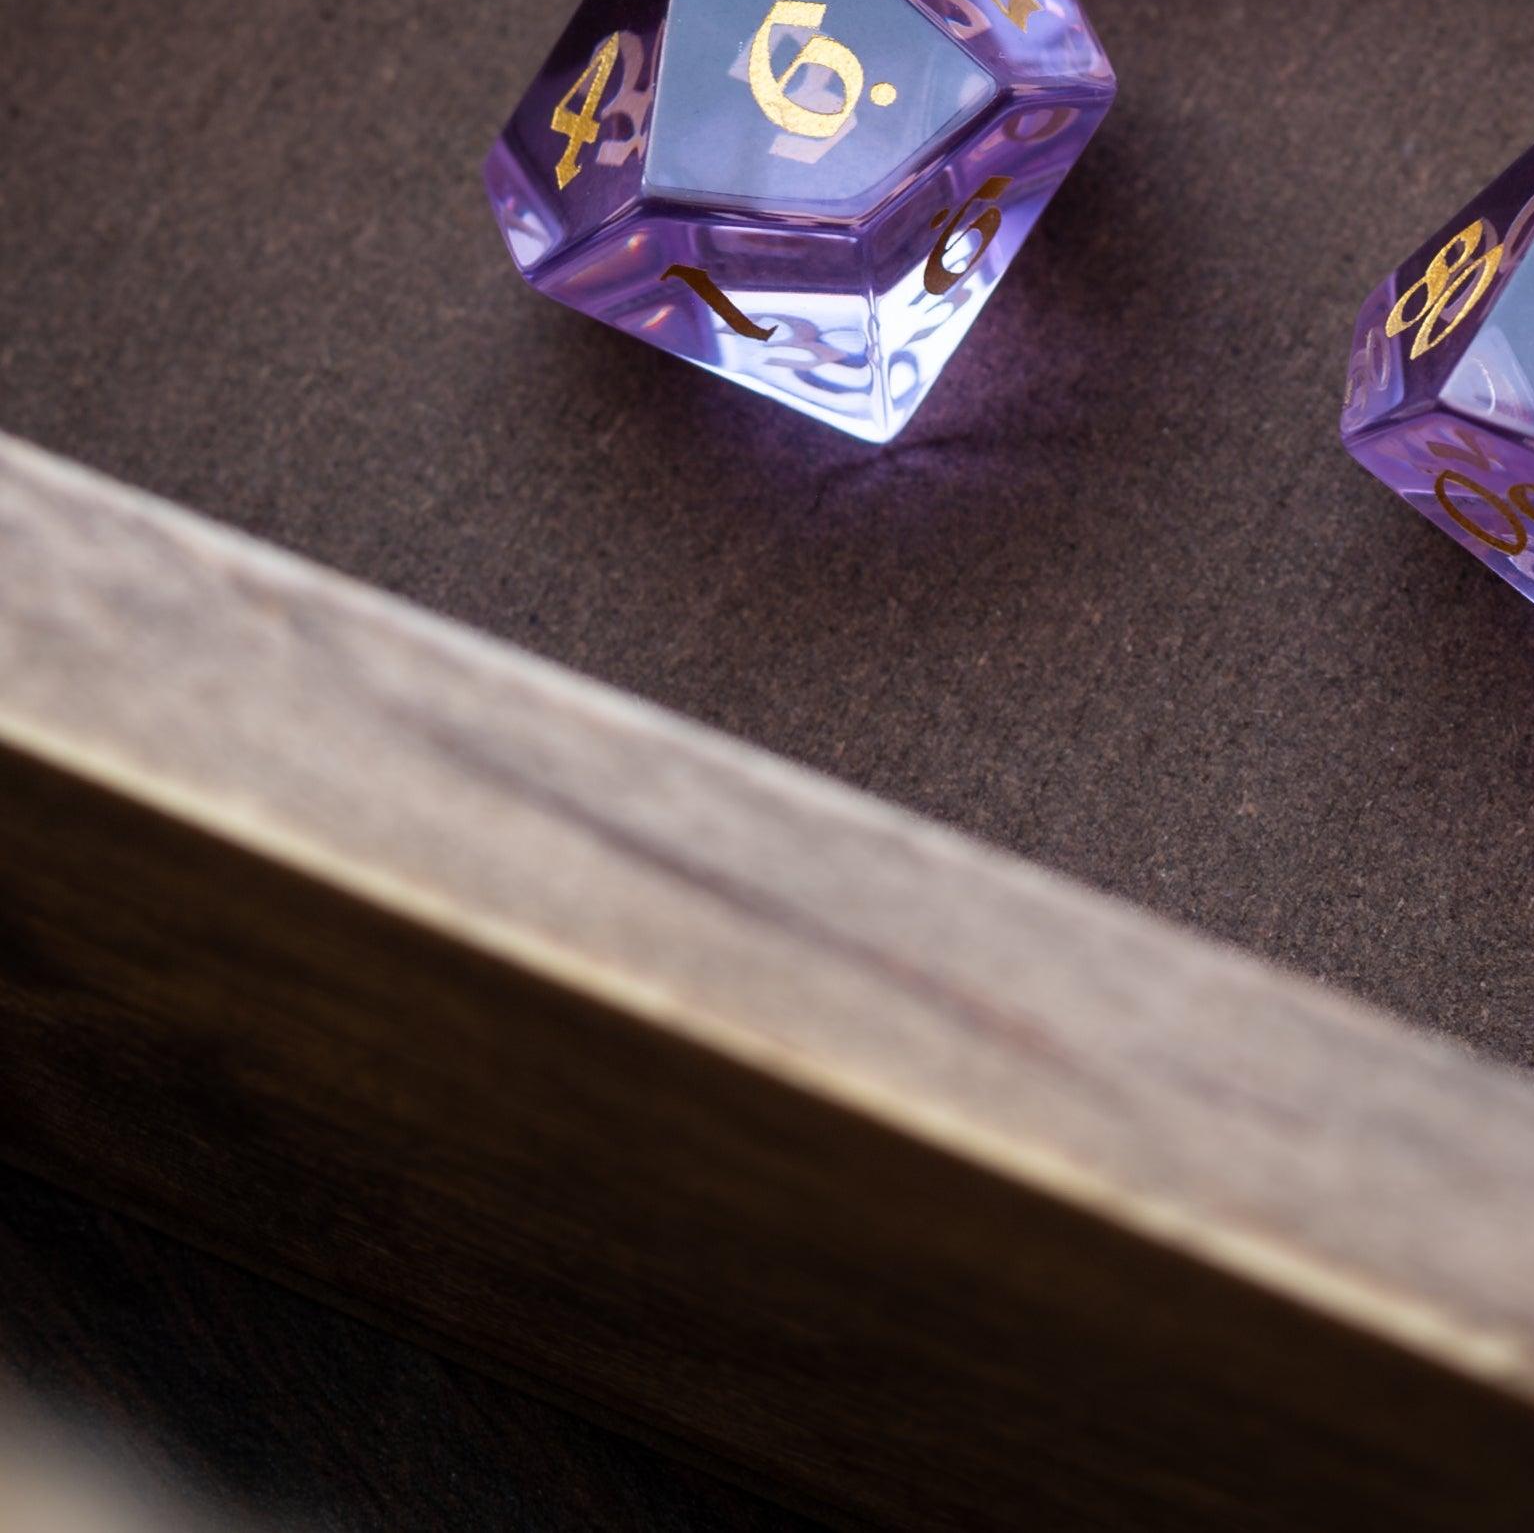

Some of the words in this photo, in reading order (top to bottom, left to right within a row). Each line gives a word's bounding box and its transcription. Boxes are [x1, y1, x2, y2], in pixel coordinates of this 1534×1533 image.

[551, 30, 620, 191] 4
[659, 264, 779, 342] 1
[1385, 217, 1504, 360] 80
